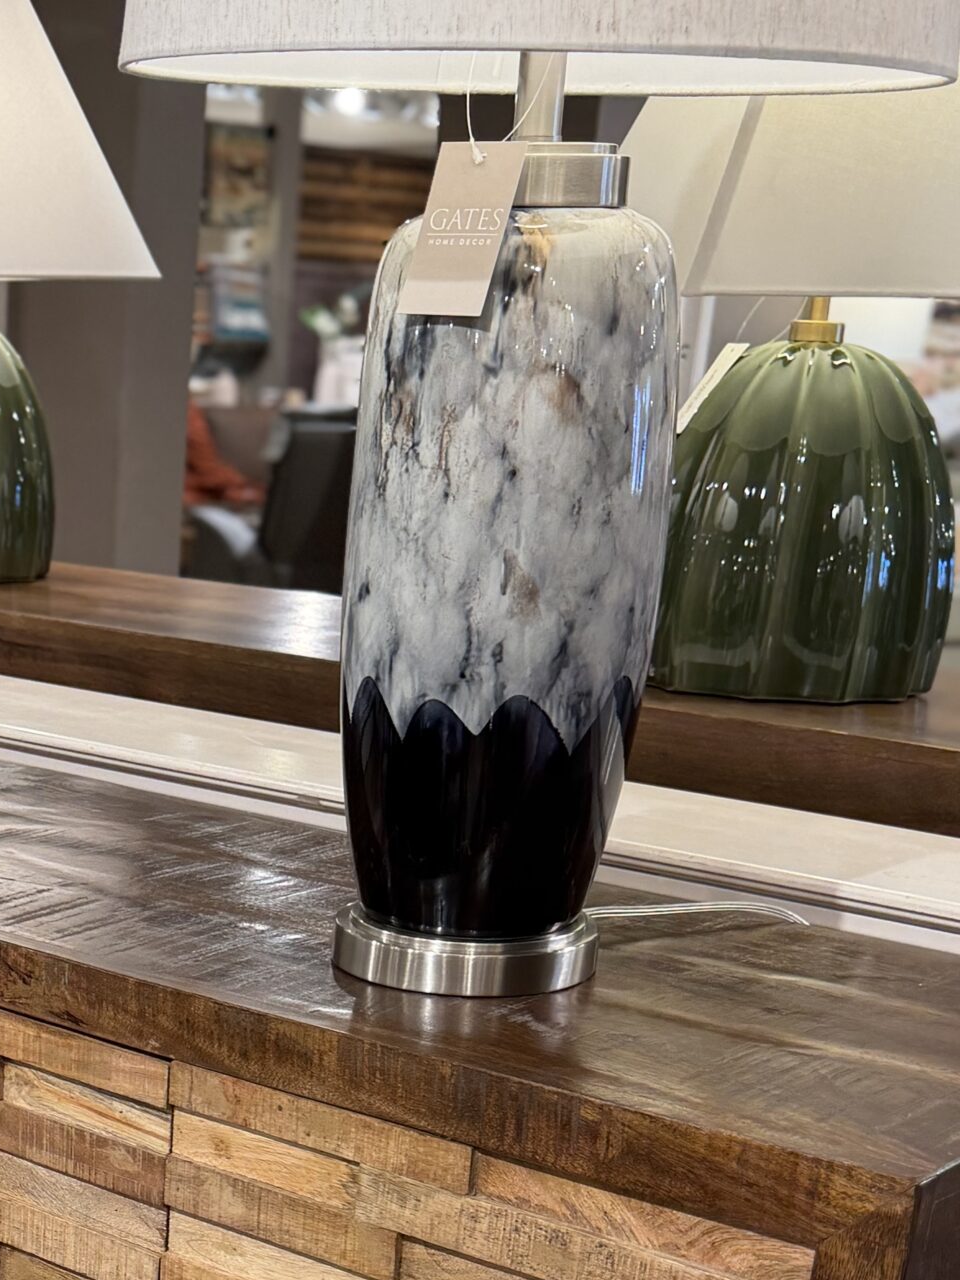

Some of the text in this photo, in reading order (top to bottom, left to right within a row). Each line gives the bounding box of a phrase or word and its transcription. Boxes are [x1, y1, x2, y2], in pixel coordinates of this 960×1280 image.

[429, 208, 505, 231] GATES
[428, 238, 492, 246] HOME DECOR
